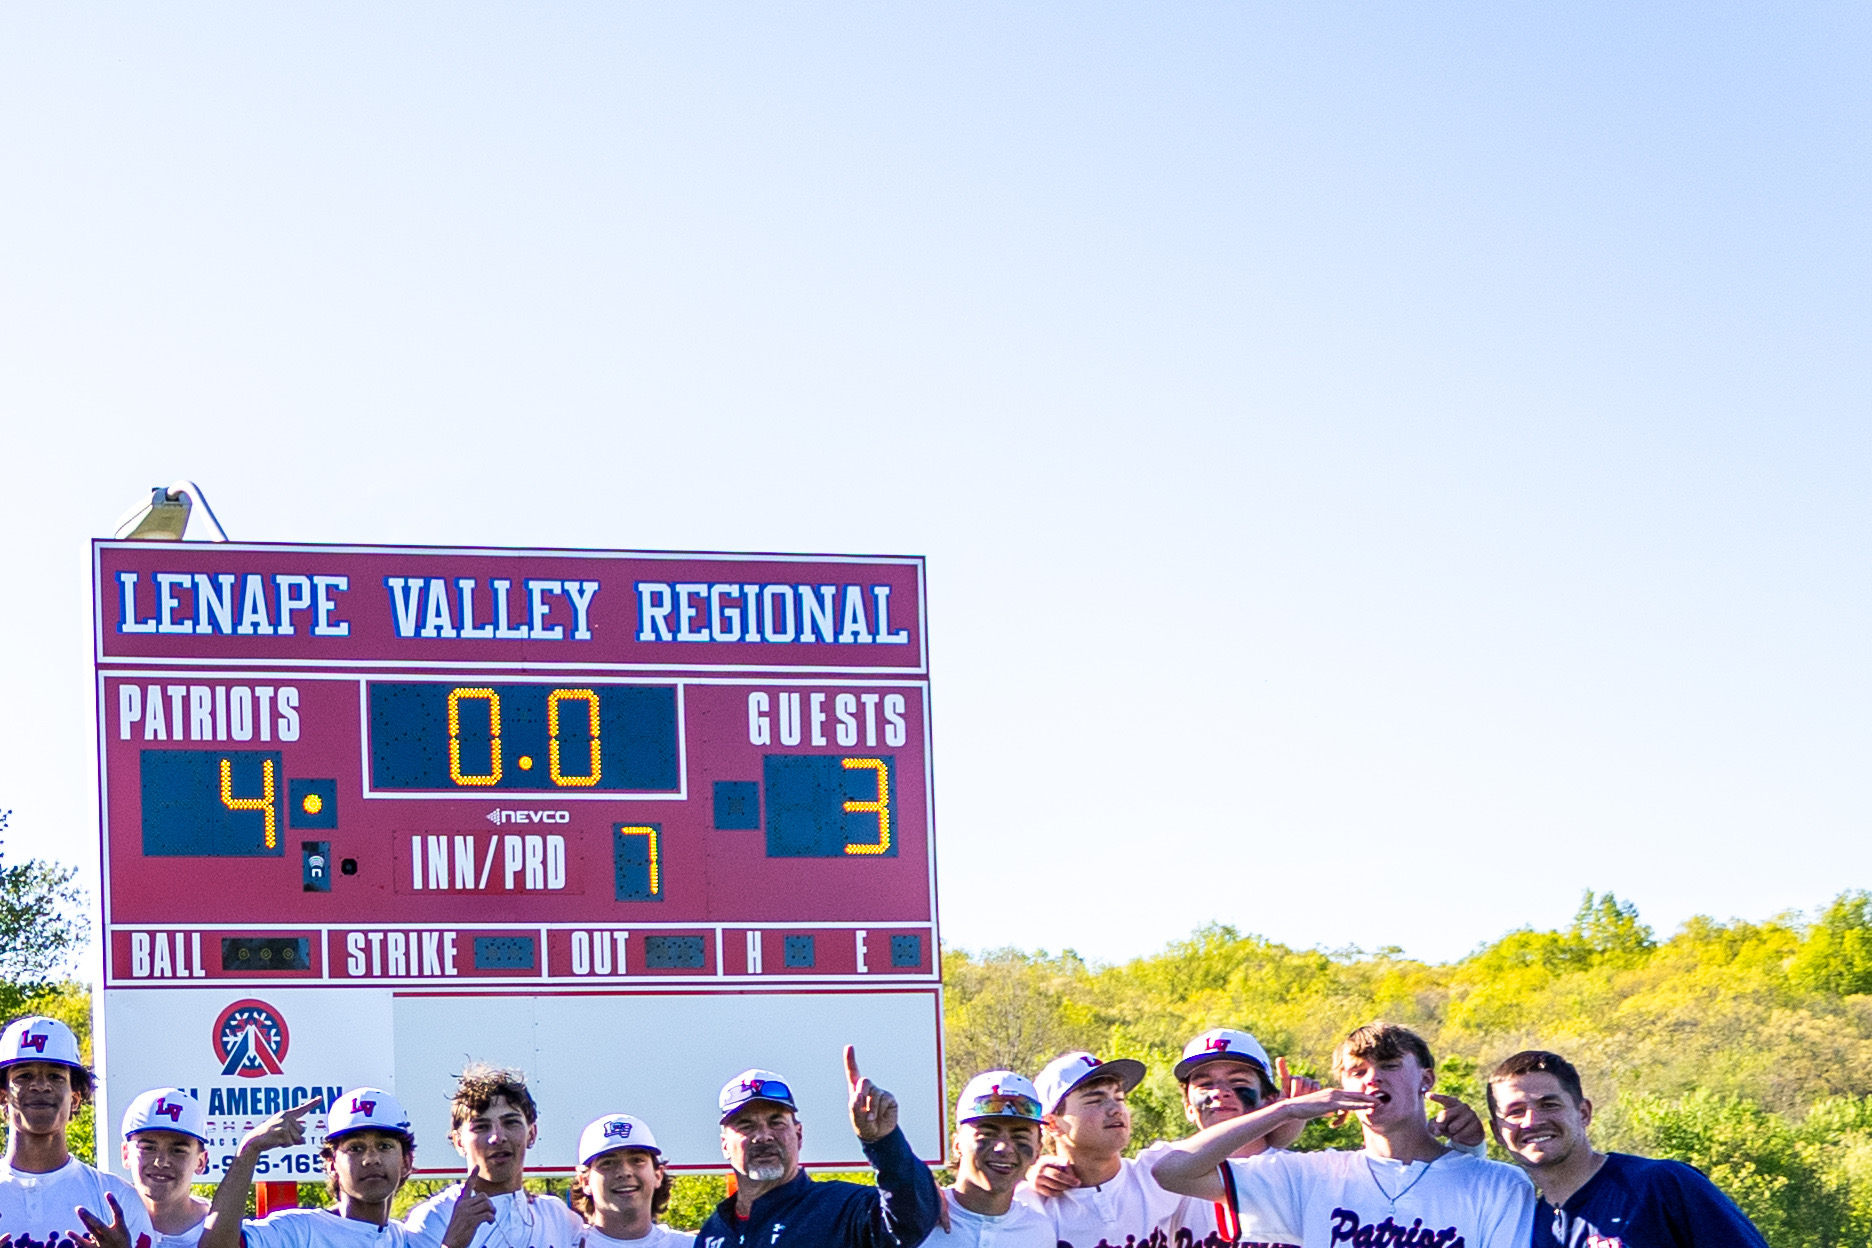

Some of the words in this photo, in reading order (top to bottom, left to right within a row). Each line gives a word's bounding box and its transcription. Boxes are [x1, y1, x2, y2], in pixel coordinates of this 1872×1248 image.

[116, 572, 350, 637] LENAPE
[384, 576, 599, 641] VALLEY
[635, 580, 910, 646] REGIONAL
[120, 684, 300, 742] PATRIOTS
[748, 691, 906, 746] GUESTS
[220, 758, 276, 849] 4
[841, 757, 890, 855] 3
[412, 834, 567, 892] INN/PRD
[621, 826, 659, 896] 7
[131, 932, 205, 977] BALL
[346, 931, 459, 977] STRIKE
[571, 930, 629, 976] OUT
[746, 930, 762, 974] H
[856, 930, 869, 973] E
